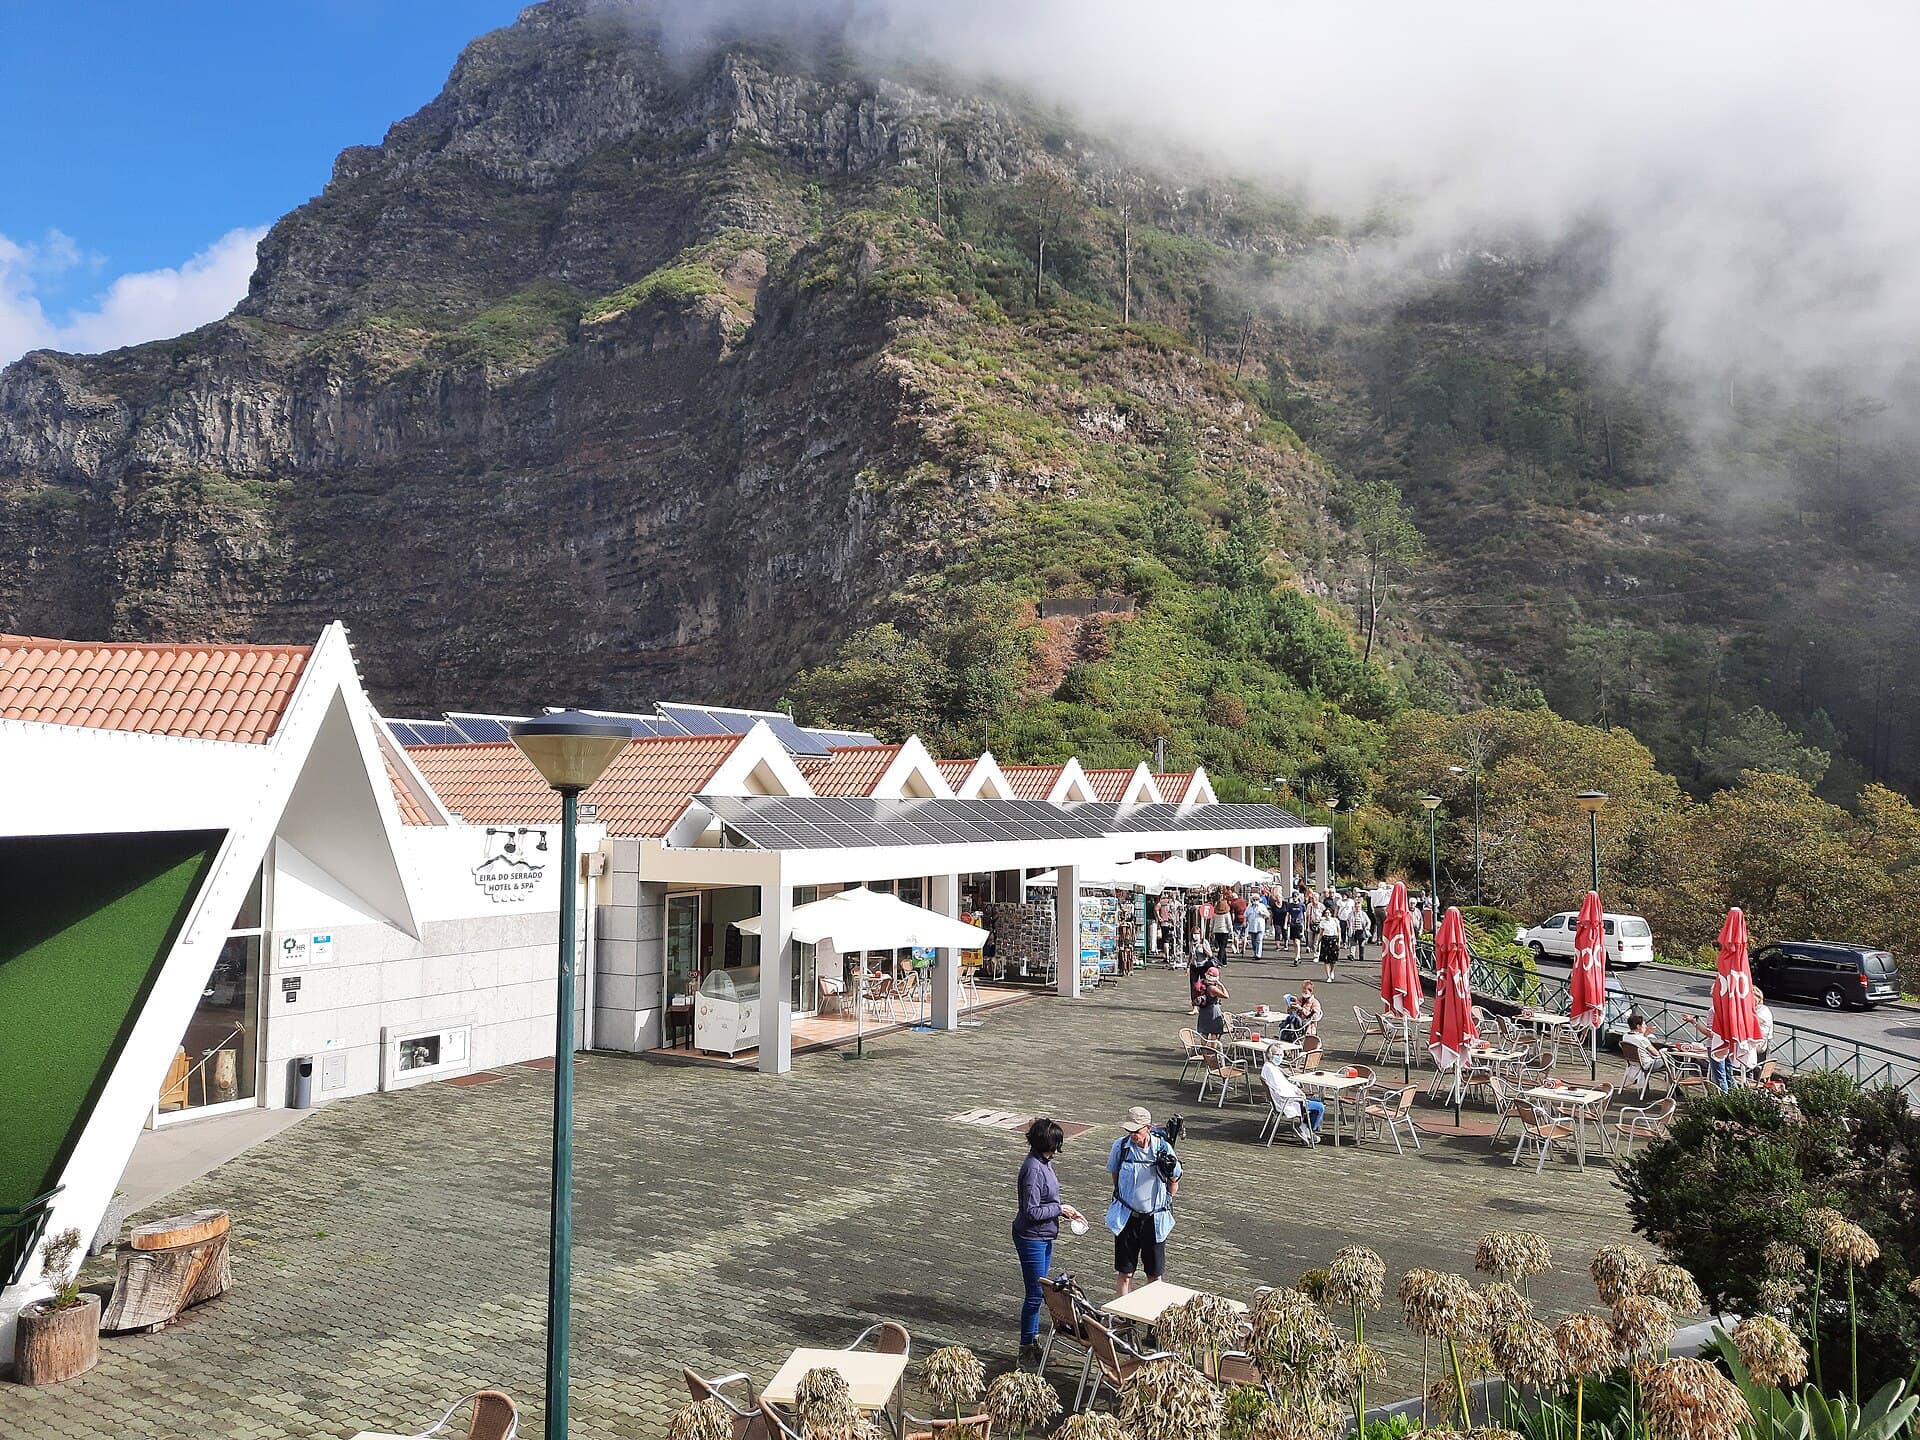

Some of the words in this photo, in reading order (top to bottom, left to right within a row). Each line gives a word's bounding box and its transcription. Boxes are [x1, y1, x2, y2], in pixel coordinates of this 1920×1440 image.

[510, 872, 543, 880] SERRADO
[489, 884, 511, 892] HOTEL
[521, 882, 534, 890] SPA
